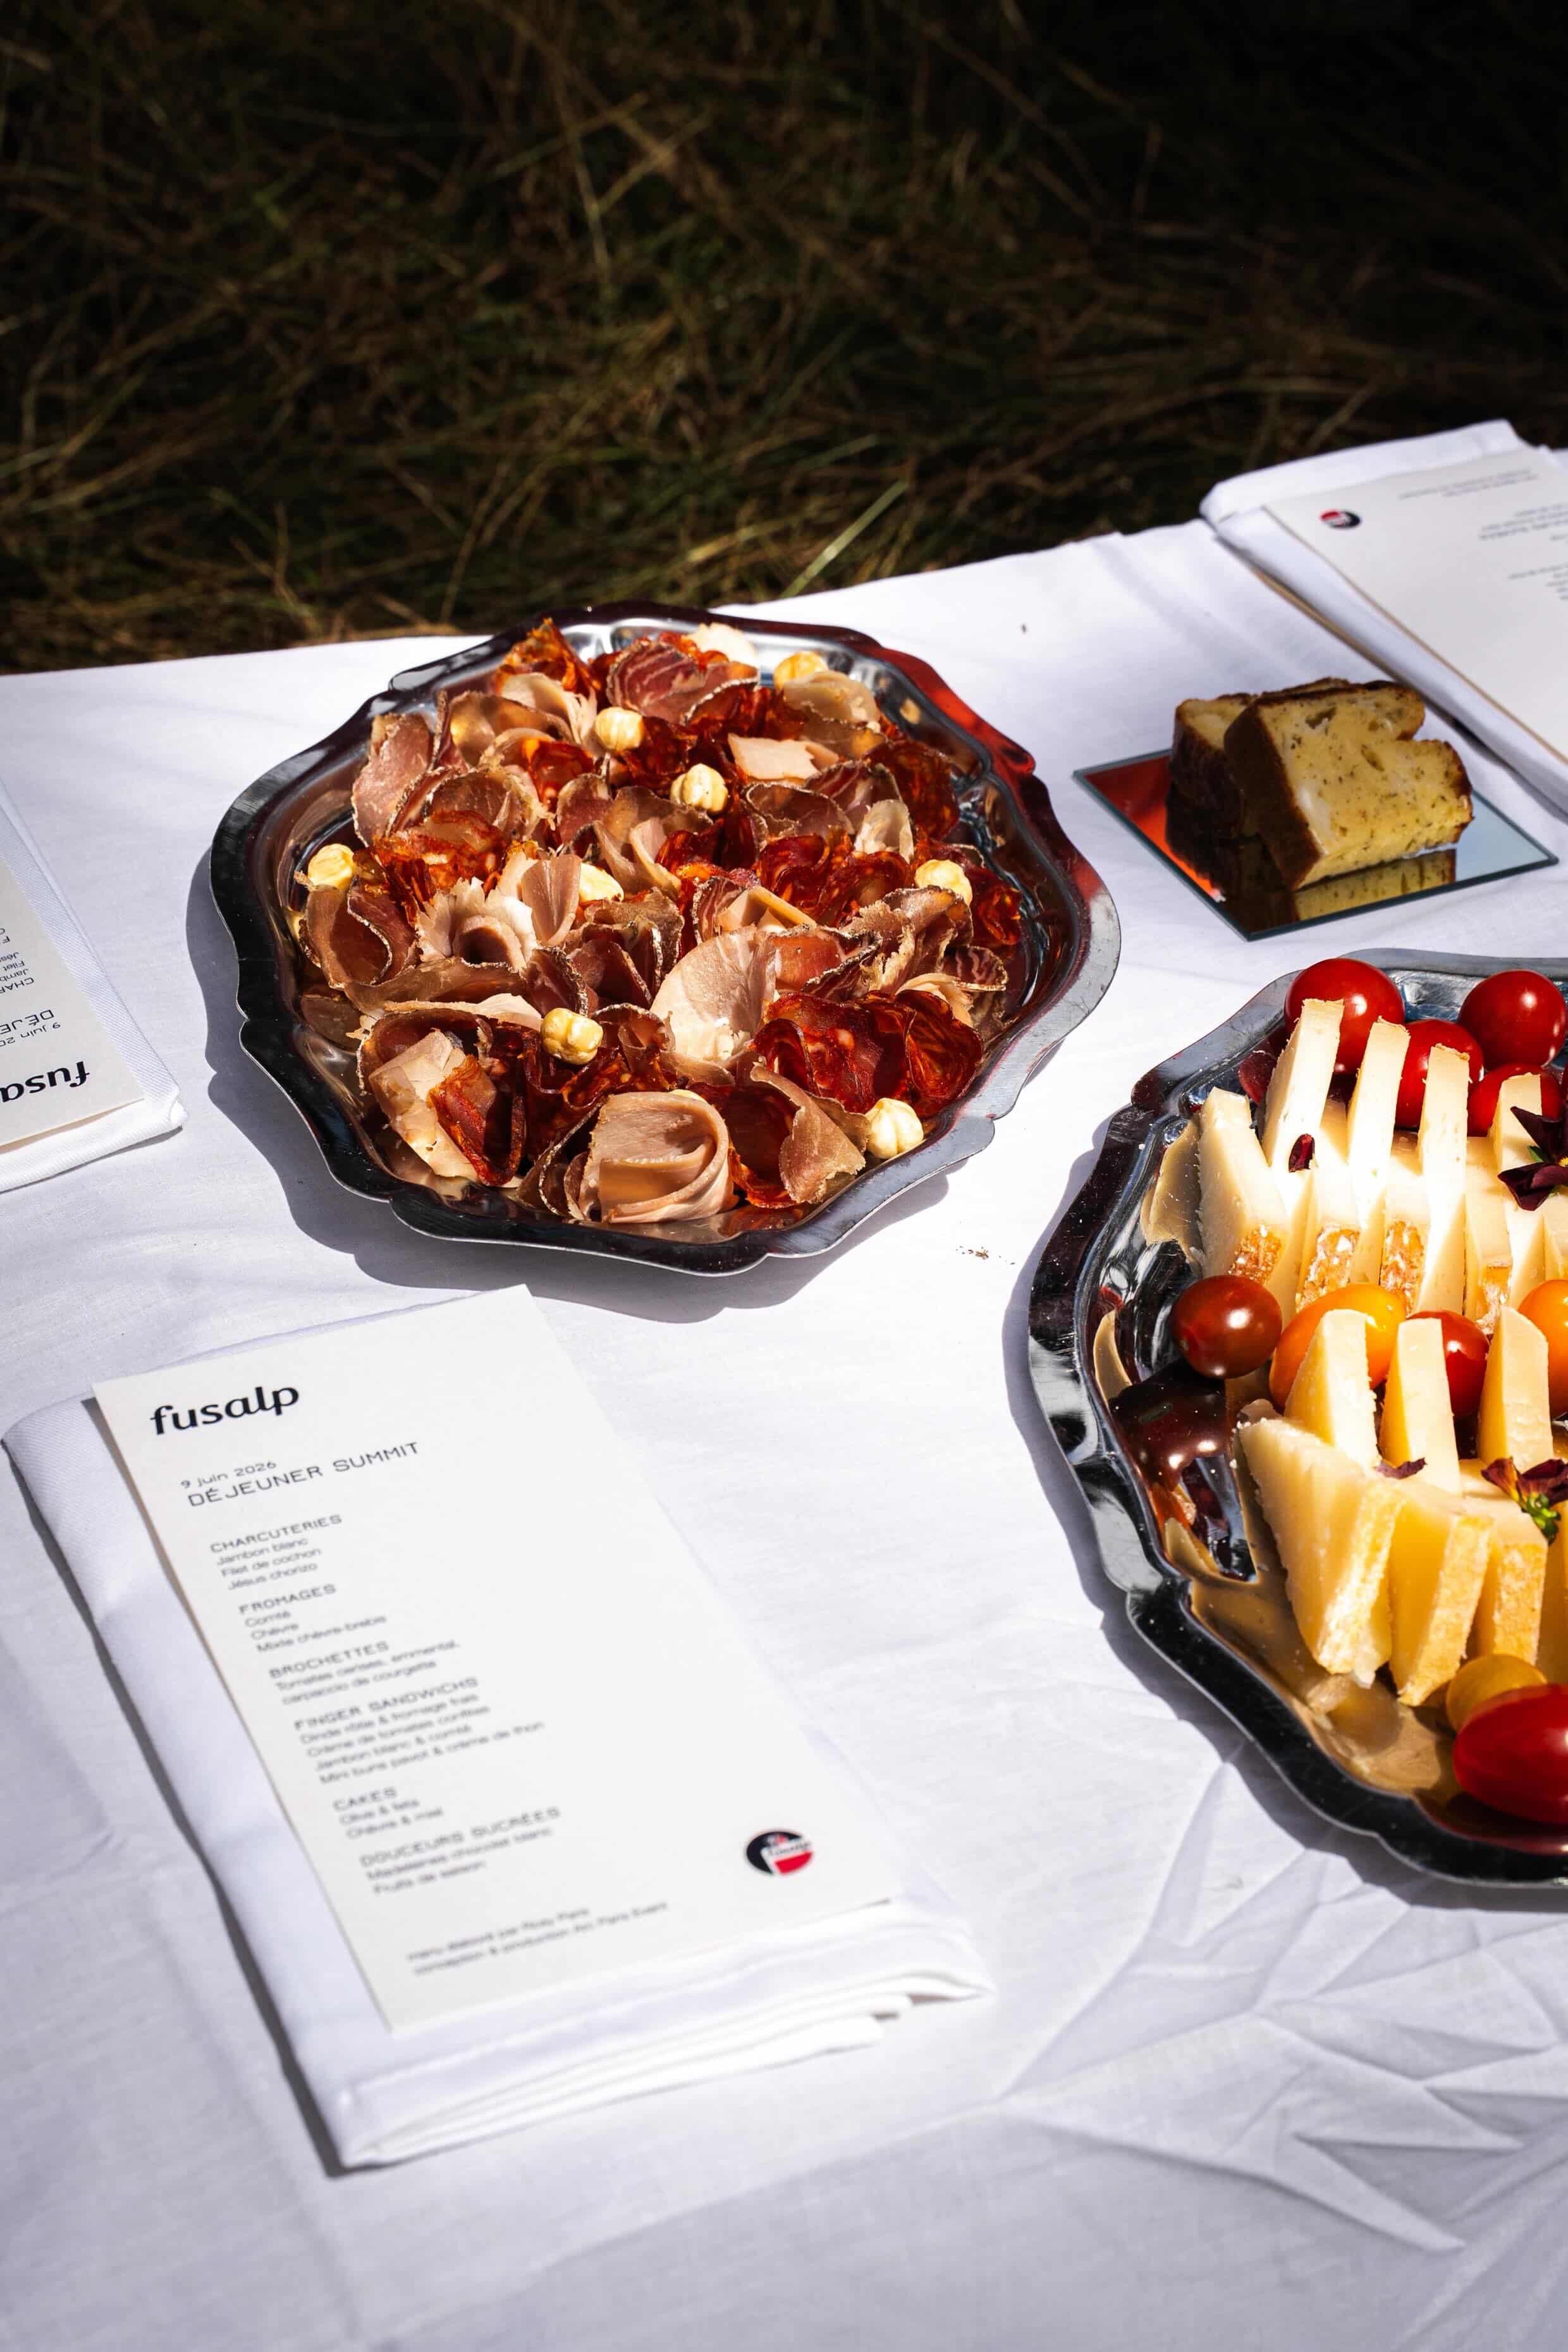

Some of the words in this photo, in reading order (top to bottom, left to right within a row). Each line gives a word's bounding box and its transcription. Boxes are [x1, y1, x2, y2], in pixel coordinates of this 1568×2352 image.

[3, 960, 25, 972] Filet
[0, 1010, 54, 1034] DÉJE
[20, 1024, 47, 1038] juin
[0, 1061, 90, 1103] fusa
[150, 1387, 299, 1435] fusalp
[181, 1480, 190, 1489] 9
[198, 1473, 228, 1487] juin
[234, 1461, 276, 1477] 2026
[188, 1466, 323, 1507] DÉJEUNER
[333, 1442, 417, 1472] SUMMIT
[210, 1514, 342, 1553] CHARCUTERIES
[217, 1548, 269, 1565] Jambon
[273, 1539, 307, 1552] blanc
[222, 1566, 247, 1576] Filet
[273, 1549, 321, 1565] cochon
[229, 1576, 266, 1589] Jésus
[270, 1564, 317, 1579] chorizo
[238, 1583, 336, 1614] FROMAGES
[245, 1612, 290, 1627] Comté
[252, 1624, 298, 1639] Chèvre
[269, 1641, 389, 1678] BROCHETTES
[276, 1674, 333, 1689] Tomates
[282, 1684, 348, 1704] carpaccio
[353, 1678, 369, 1686] de
[373, 1662, 436, 1681] courgette
[295, 1707, 360, 1729] FINGER
[369, 1678, 478, 1710] SANDWICHS
[301, 1729, 341, 1743] Dinde
[392, 1703, 446, 1719] fromage
[308, 1741, 353, 1756] Crème
[358, 1736, 375, 1744] de
[317, 1751, 371, 1770] Jambon
[374, 1743, 410, 1755] blanc
[434, 1747, 443, 1755] &
[333, 1787, 396, 1810] CAKES
[401, 1816, 410, 1824] &
[360, 1832, 463, 1866] DOUCEURS
[472, 1808, 560, 1839] SUCRÉES
